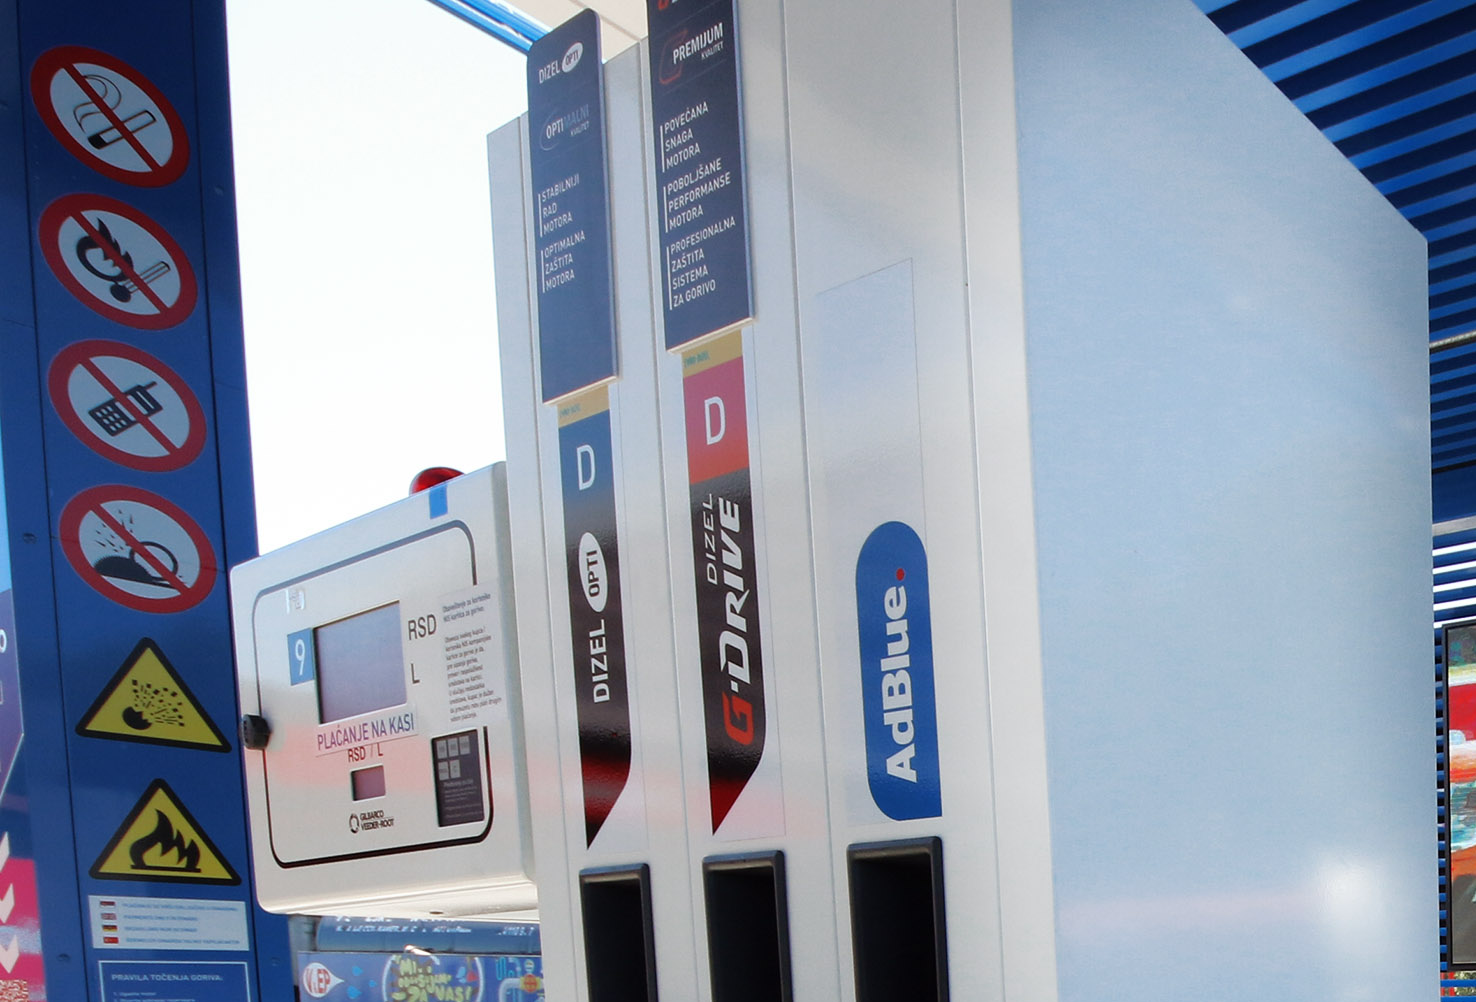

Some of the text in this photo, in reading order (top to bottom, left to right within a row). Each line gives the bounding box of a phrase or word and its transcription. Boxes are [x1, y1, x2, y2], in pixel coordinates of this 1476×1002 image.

[673, 22, 724, 65] PREMIJUM
[539, 60, 560, 84] DIZEL
[665, 128, 693, 152] SNAGA
[666, 142, 701, 169] MOTORA
[542, 173, 580, 203] STABILNIJI
[667, 157, 722, 195] POBOLJŠANE
[668, 171, 731, 213] PERFORMANSE
[543, 203, 557, 218] RAD
[543, 211, 573, 235] MOTORA
[669, 204, 704, 230] MOTORA
[544, 230, 586, 259] OPTIMALNA
[670, 216, 736, 255] PROFESIONALNA
[671, 248, 705, 273] ZAŠTITA
[546, 269, 575, 292] MOTORA
[672, 264, 709, 290] SISTEMA
[673, 279, 716, 308] ZA GORIVO
[704, 396, 726, 445] D
[576, 444, 596, 491] D
[702, 493, 718, 585] DIZEL
[408, 614, 437, 640] RSD
[586, 550, 610, 703] DIZEL OPTI
[719, 497, 754, 746] G-DRIVE
[294, 638, 307, 676] 9
[411, 663, 420, 685] L
[881, 585, 918, 783] AdBlue
[317, 712, 415, 751] PLAĆANJE NA KASI
[348, 745, 365, 762] RSD
[377, 743, 384, 757] L
[112, 974, 149, 982] PRAVILA
